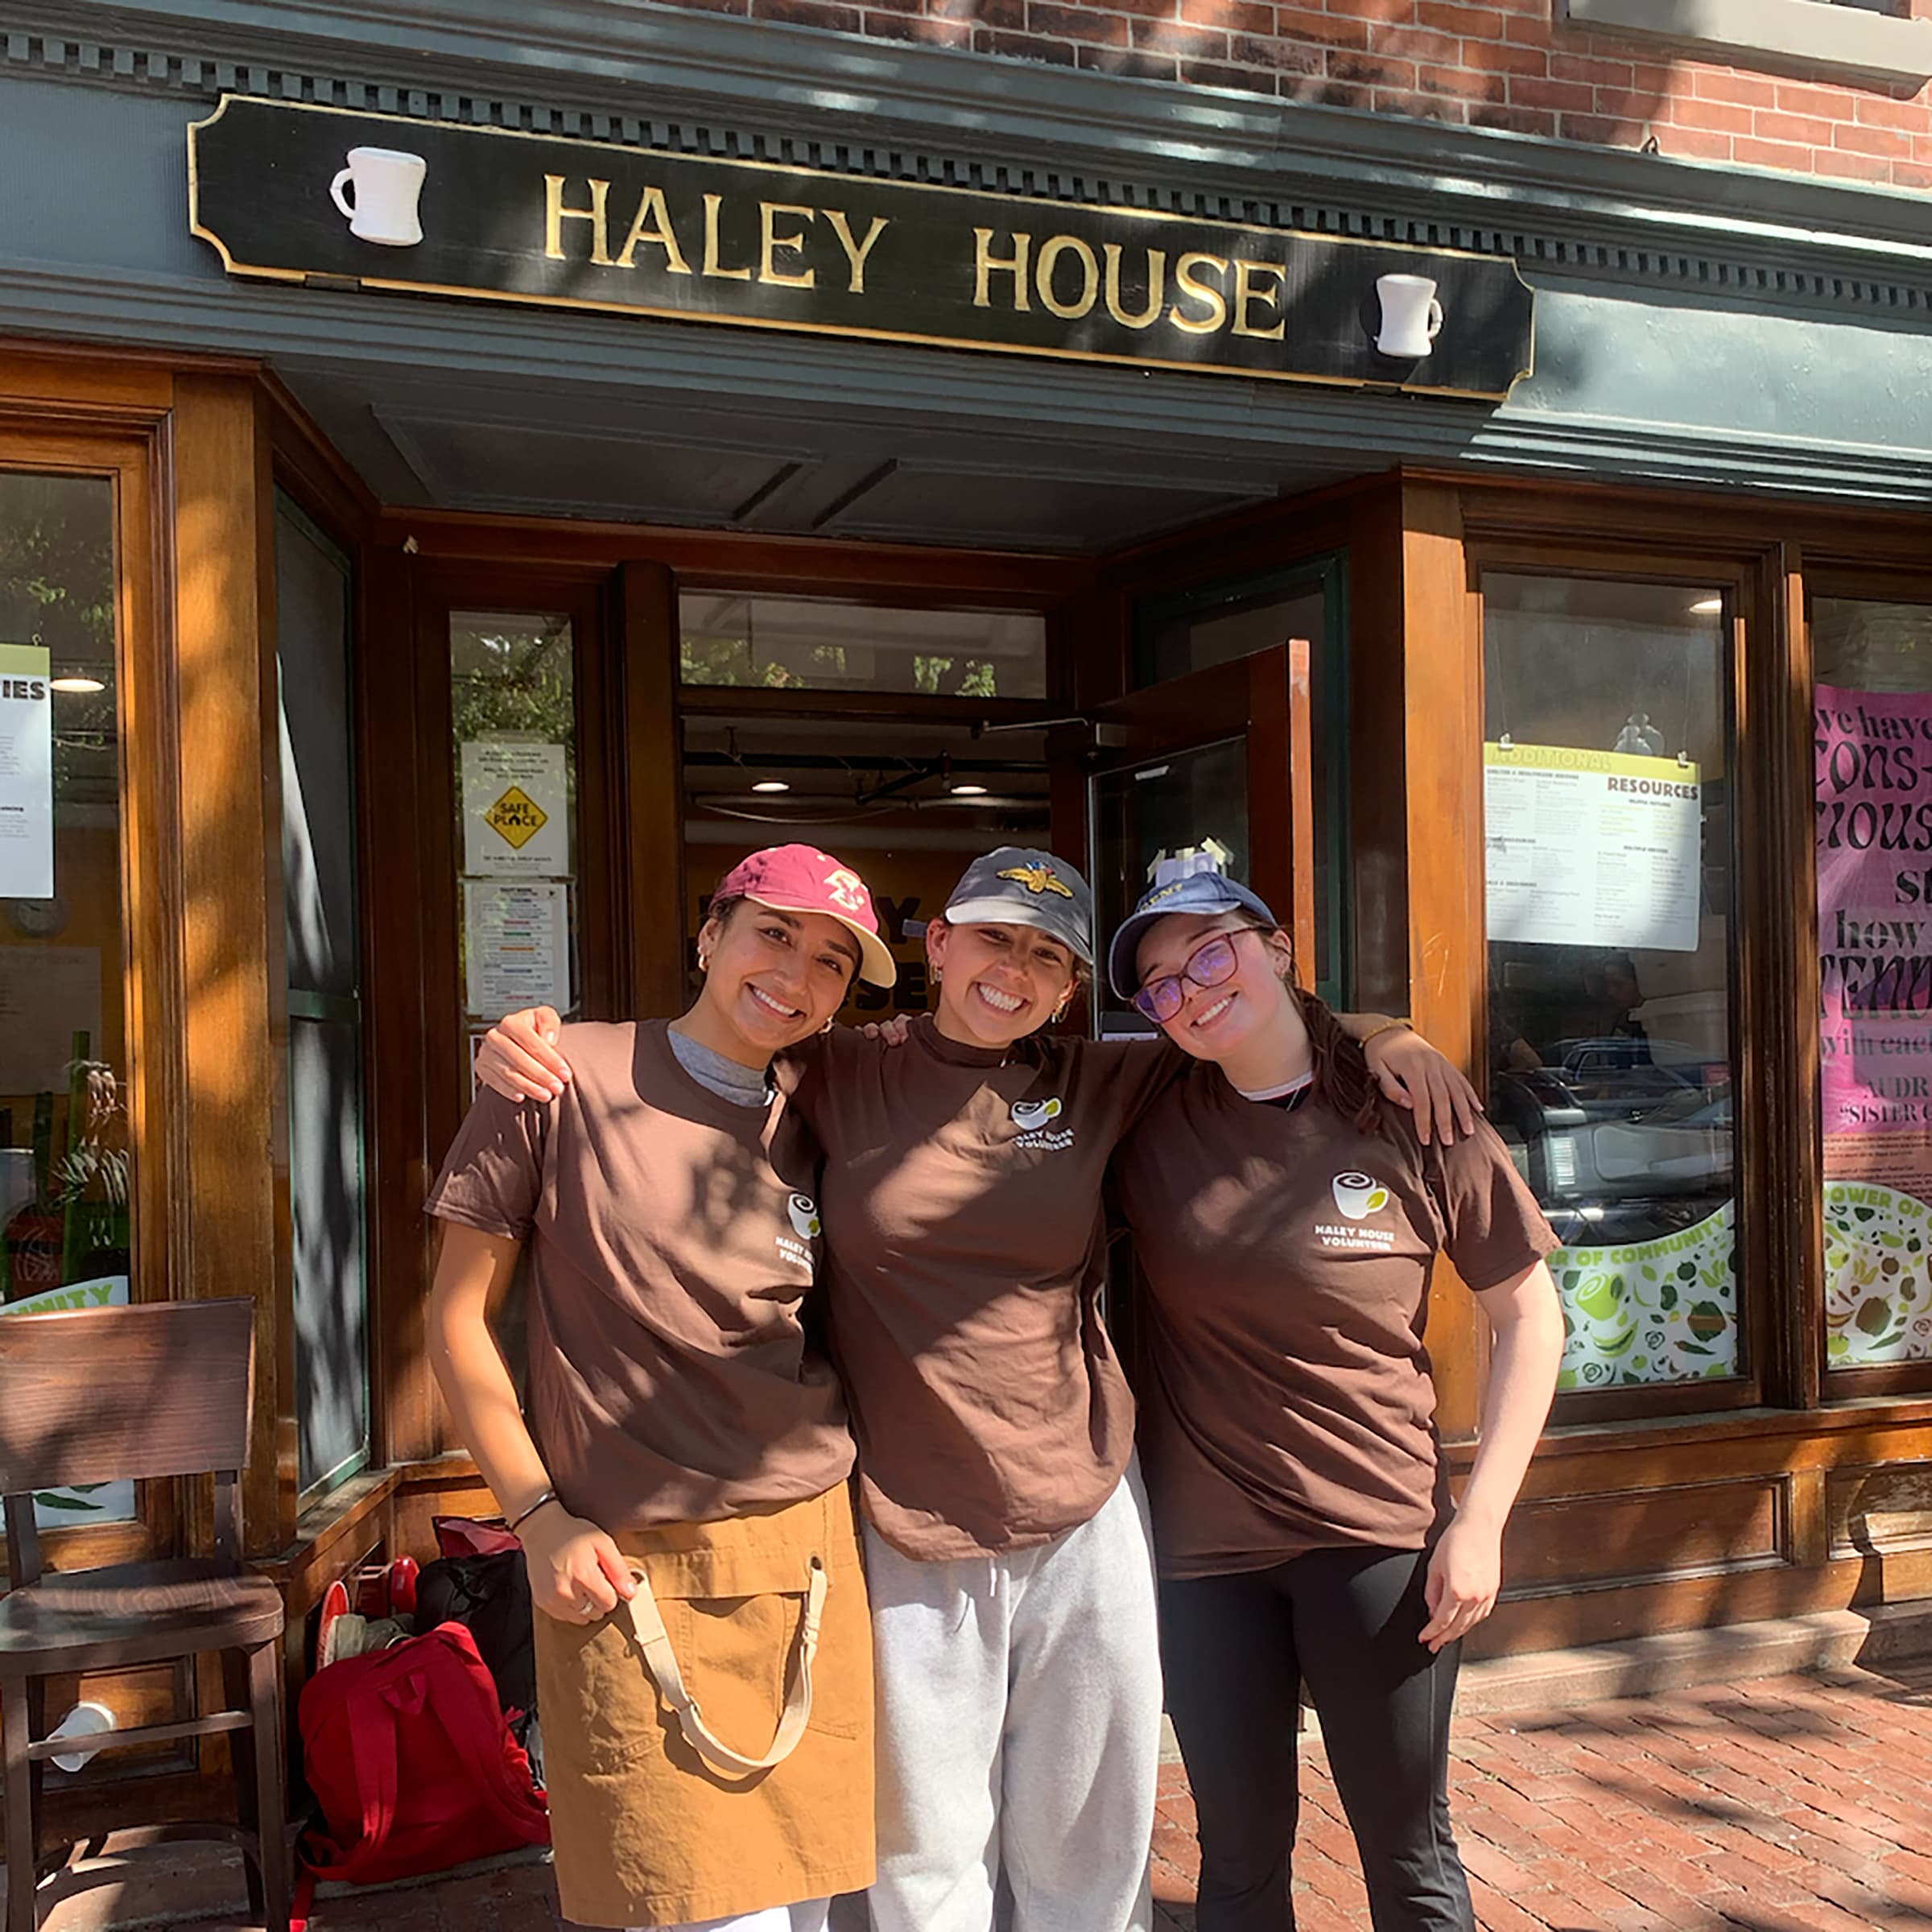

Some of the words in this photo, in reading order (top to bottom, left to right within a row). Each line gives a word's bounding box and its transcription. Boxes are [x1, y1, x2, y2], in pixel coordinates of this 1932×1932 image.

[544, 174, 890, 294] HALEY
[973, 228, 1286, 341] HOUSE
[1608, 777, 1699, 800] RESOURCES
[500, 803, 529, 814] SAFE
[1836, 908, 1926, 948] how
[1821, 1029, 1874, 1055] with
[1897, 1198, 1925, 1218] OF
[1576, 1250, 1604, 1266] OF
[1610, 1212, 1725, 1265] COMMUNITY
